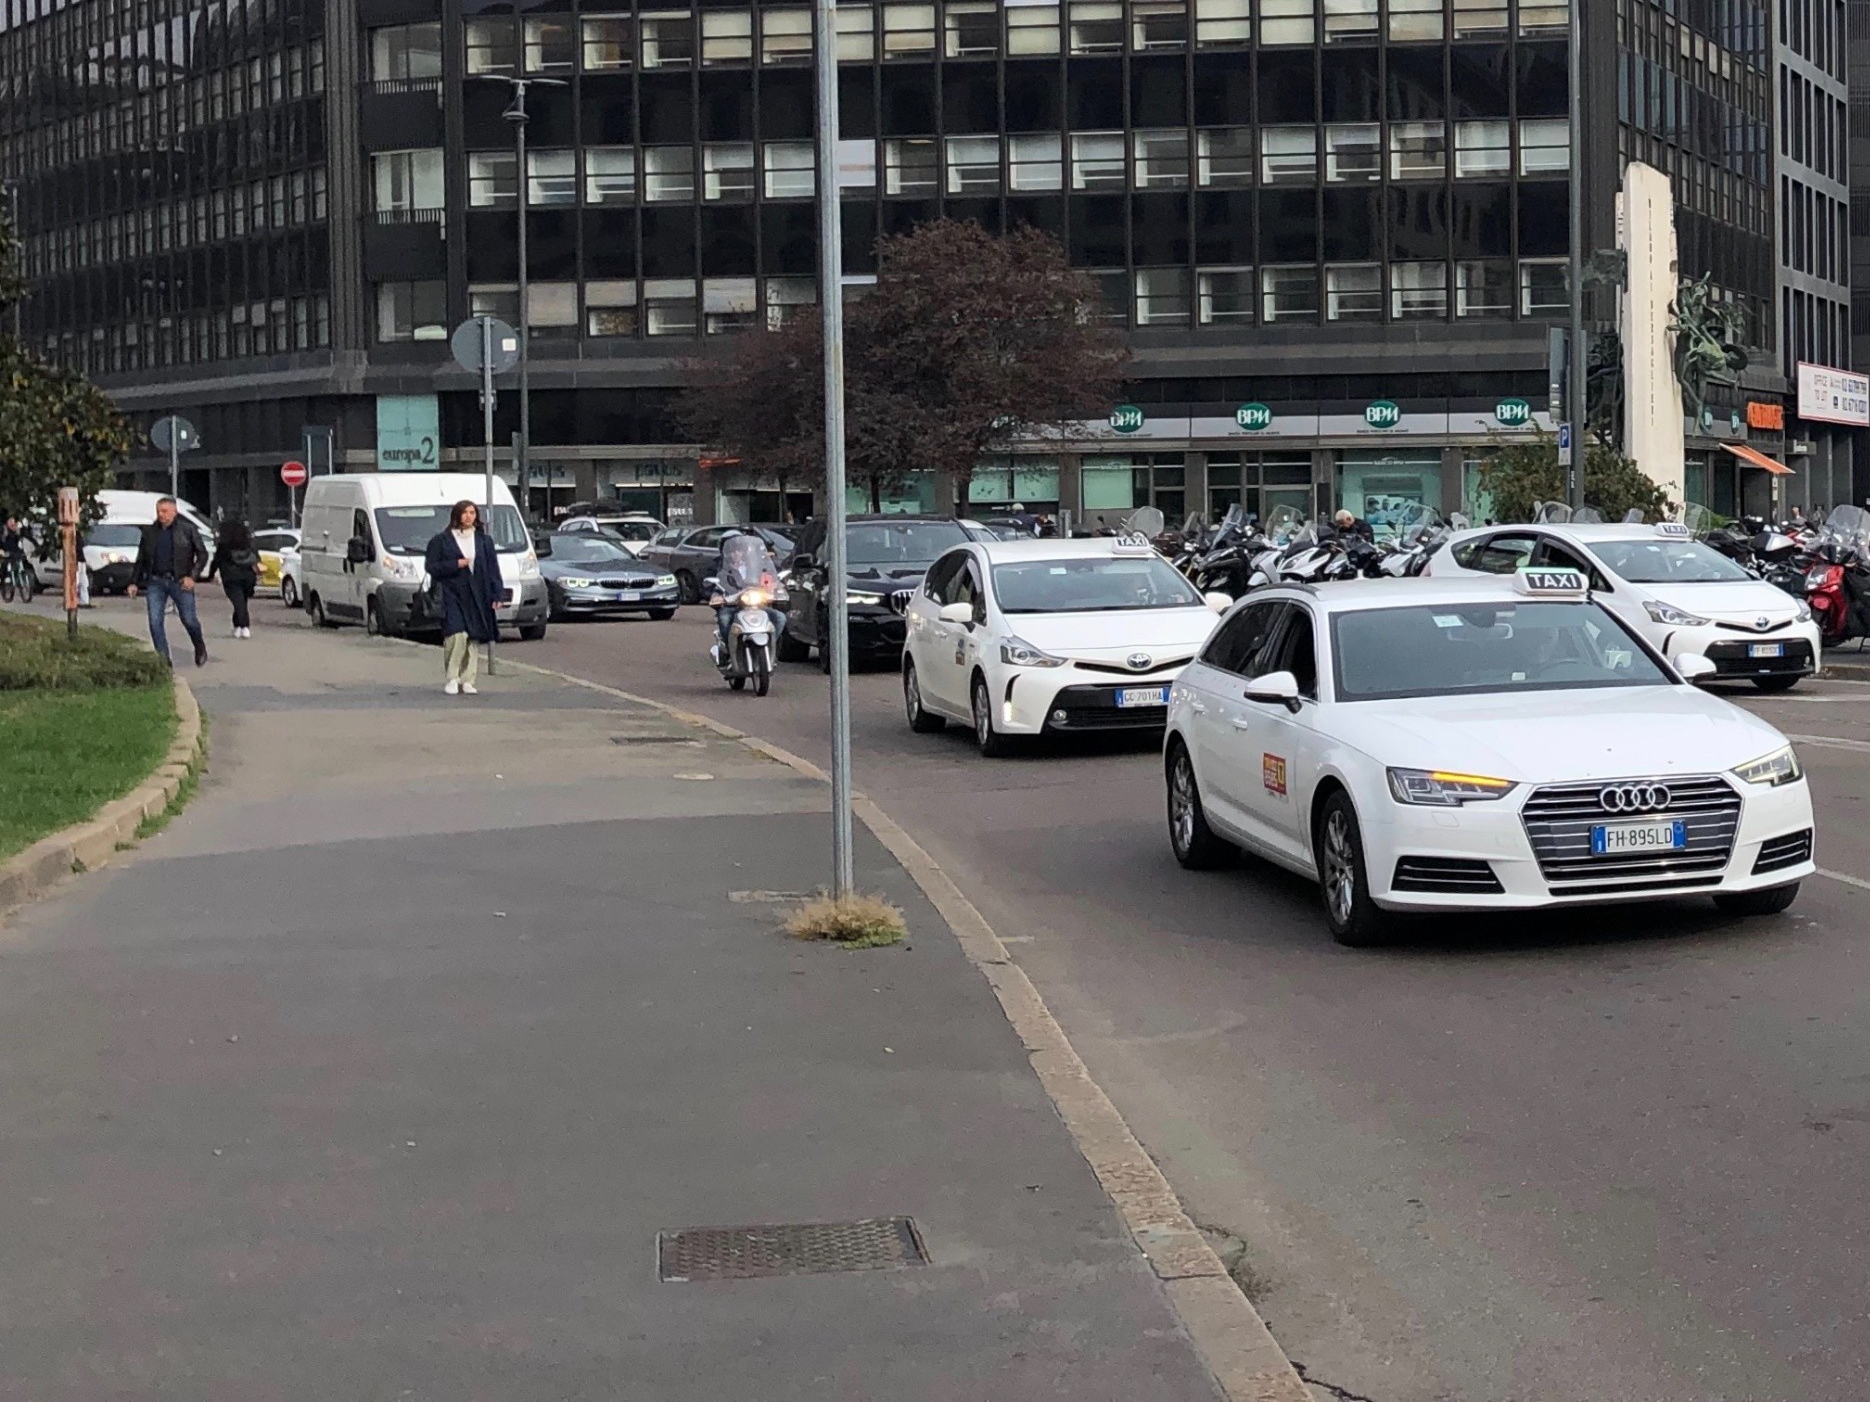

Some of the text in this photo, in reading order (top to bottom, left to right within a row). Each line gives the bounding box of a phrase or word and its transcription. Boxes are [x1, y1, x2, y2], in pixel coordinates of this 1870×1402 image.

[1236, 408, 1270, 425] BPM
[1366, 406, 1399, 423] BPM
[1496, 404, 1529, 420] BPM
[1561, 429, 1568, 445] P
[382, 436, 435, 465] europa 2
[1664, 525, 1687, 534] TAXI
[1116, 537, 1147, 546] TAXI
[1529, 573, 1579, 588] TAXI
